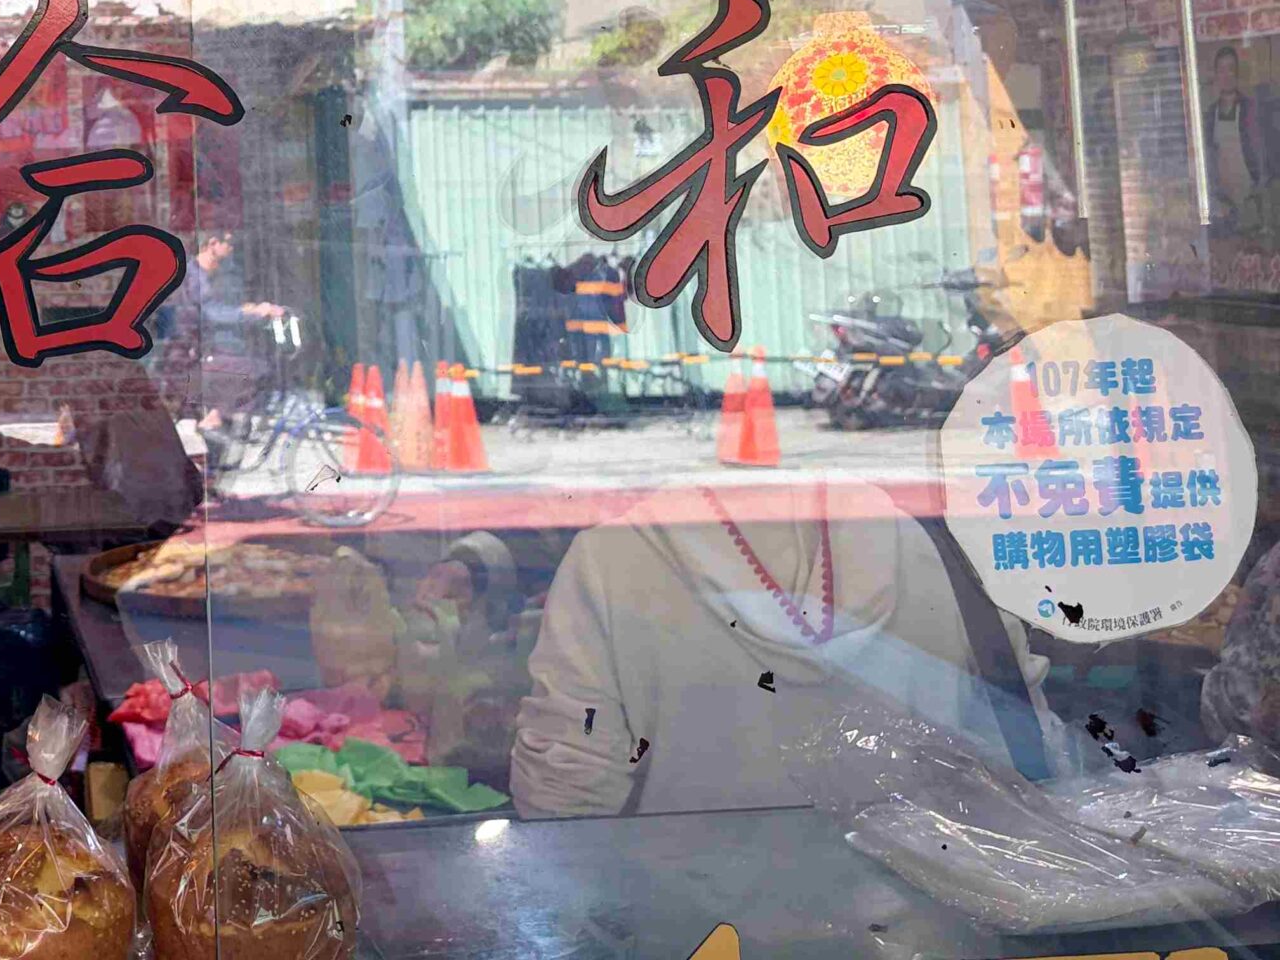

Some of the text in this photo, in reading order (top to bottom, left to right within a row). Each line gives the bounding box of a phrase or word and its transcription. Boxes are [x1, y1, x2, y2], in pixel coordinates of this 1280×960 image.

[1026, 357, 1157, 398] 107年起
[992, 521, 1215, 571] 購物用塑膠袋
